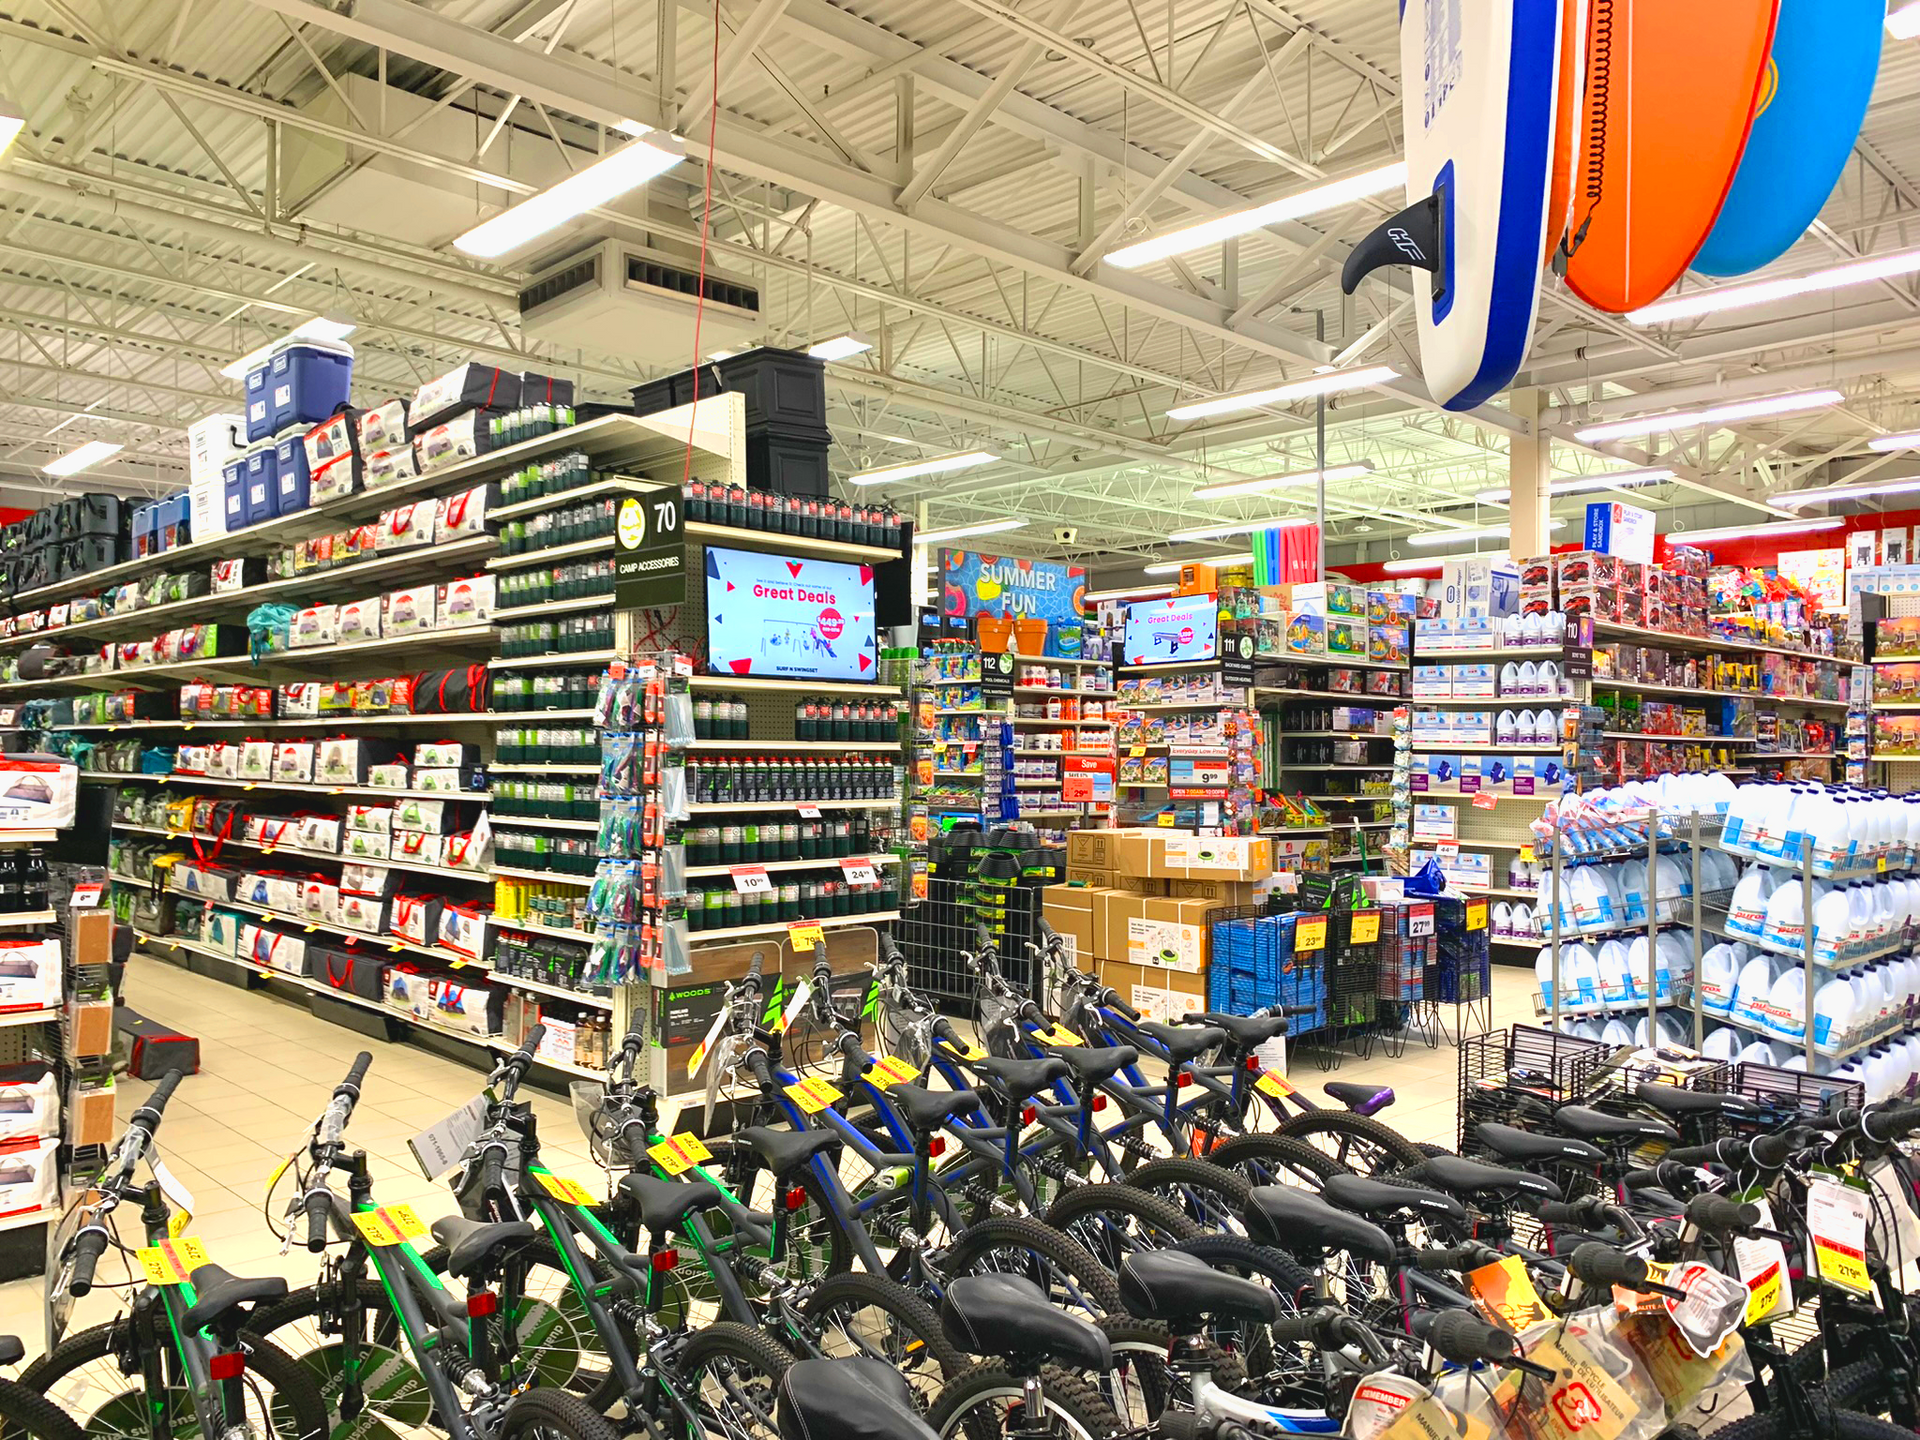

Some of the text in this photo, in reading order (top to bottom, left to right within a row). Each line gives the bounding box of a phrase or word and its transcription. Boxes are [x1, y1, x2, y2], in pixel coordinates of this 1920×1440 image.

[654, 501, 676, 533] 70
[620, 556, 679, 574] CAMP ACCESSORIES
[980, 563, 1056, 591] SUMMER
[753, 584, 836, 605] Great Deals
[1001, 592, 1036, 614] FUN
[1148, 612, 1194, 625] Great Deals
[1567, 623, 1578, 639] 110
[1224, 638, 1235, 653] 111
[983, 657, 996, 669] 112
[1172, 747, 1198, 755] Everyday
[1081, 759, 1098, 769] Save
[676, 987, 712, 999] WOODS
[546, 1324, 564, 1346] dual
[1576, 1367, 1588, 1379] DE
[1580, 1360, 1607, 1389] BICYCLE
[1361, 1389, 1407, 1408] REMEMBER
